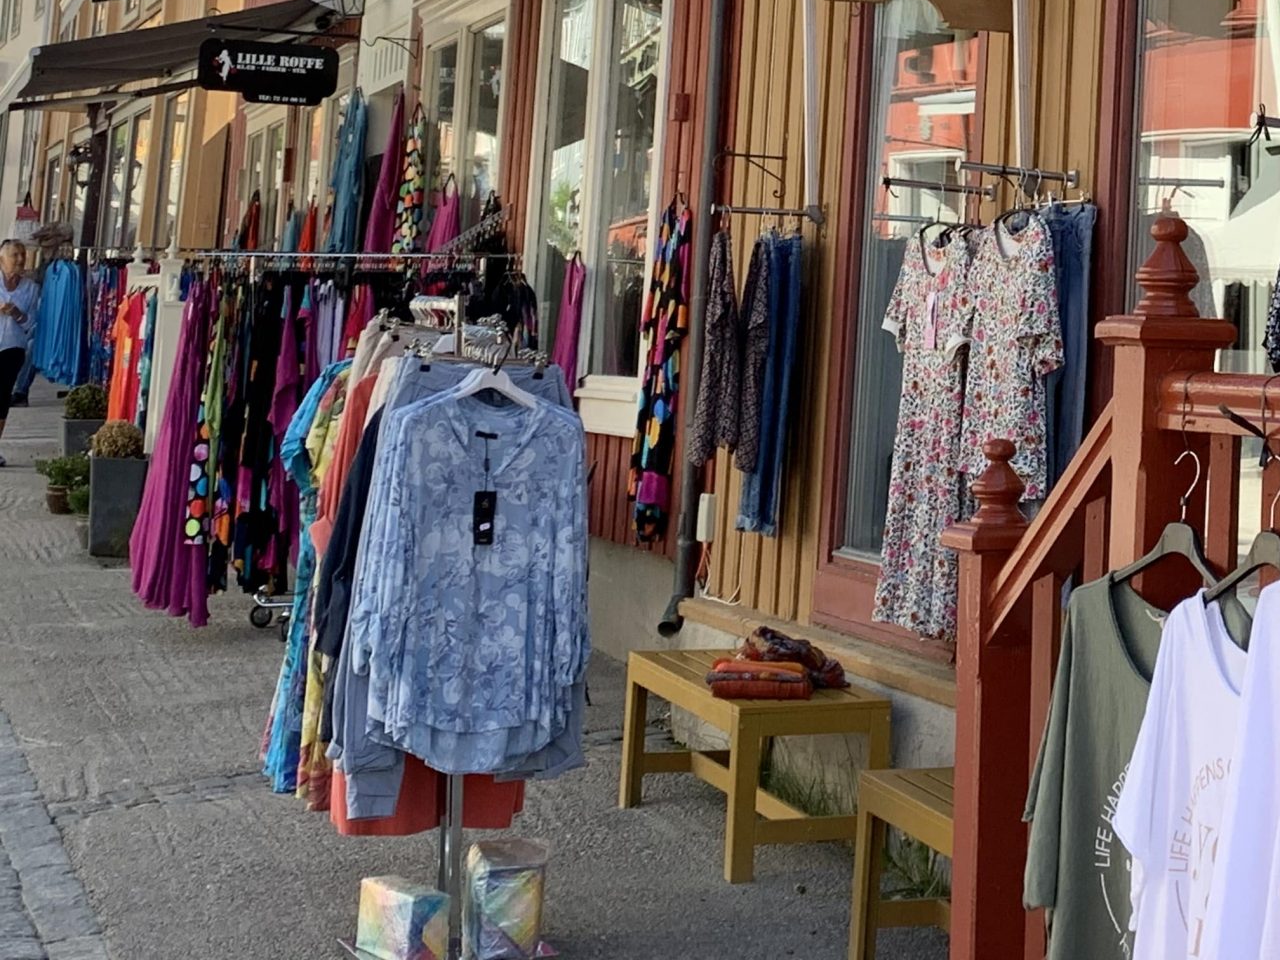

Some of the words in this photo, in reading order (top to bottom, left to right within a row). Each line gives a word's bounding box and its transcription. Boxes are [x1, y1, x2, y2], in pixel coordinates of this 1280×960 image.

[237, 52, 276, 66] LILLE
[280, 55, 324, 70] ROFFE
[1094, 826, 1113, 868] LIFE
[1168, 830, 1192, 872] LIFE
